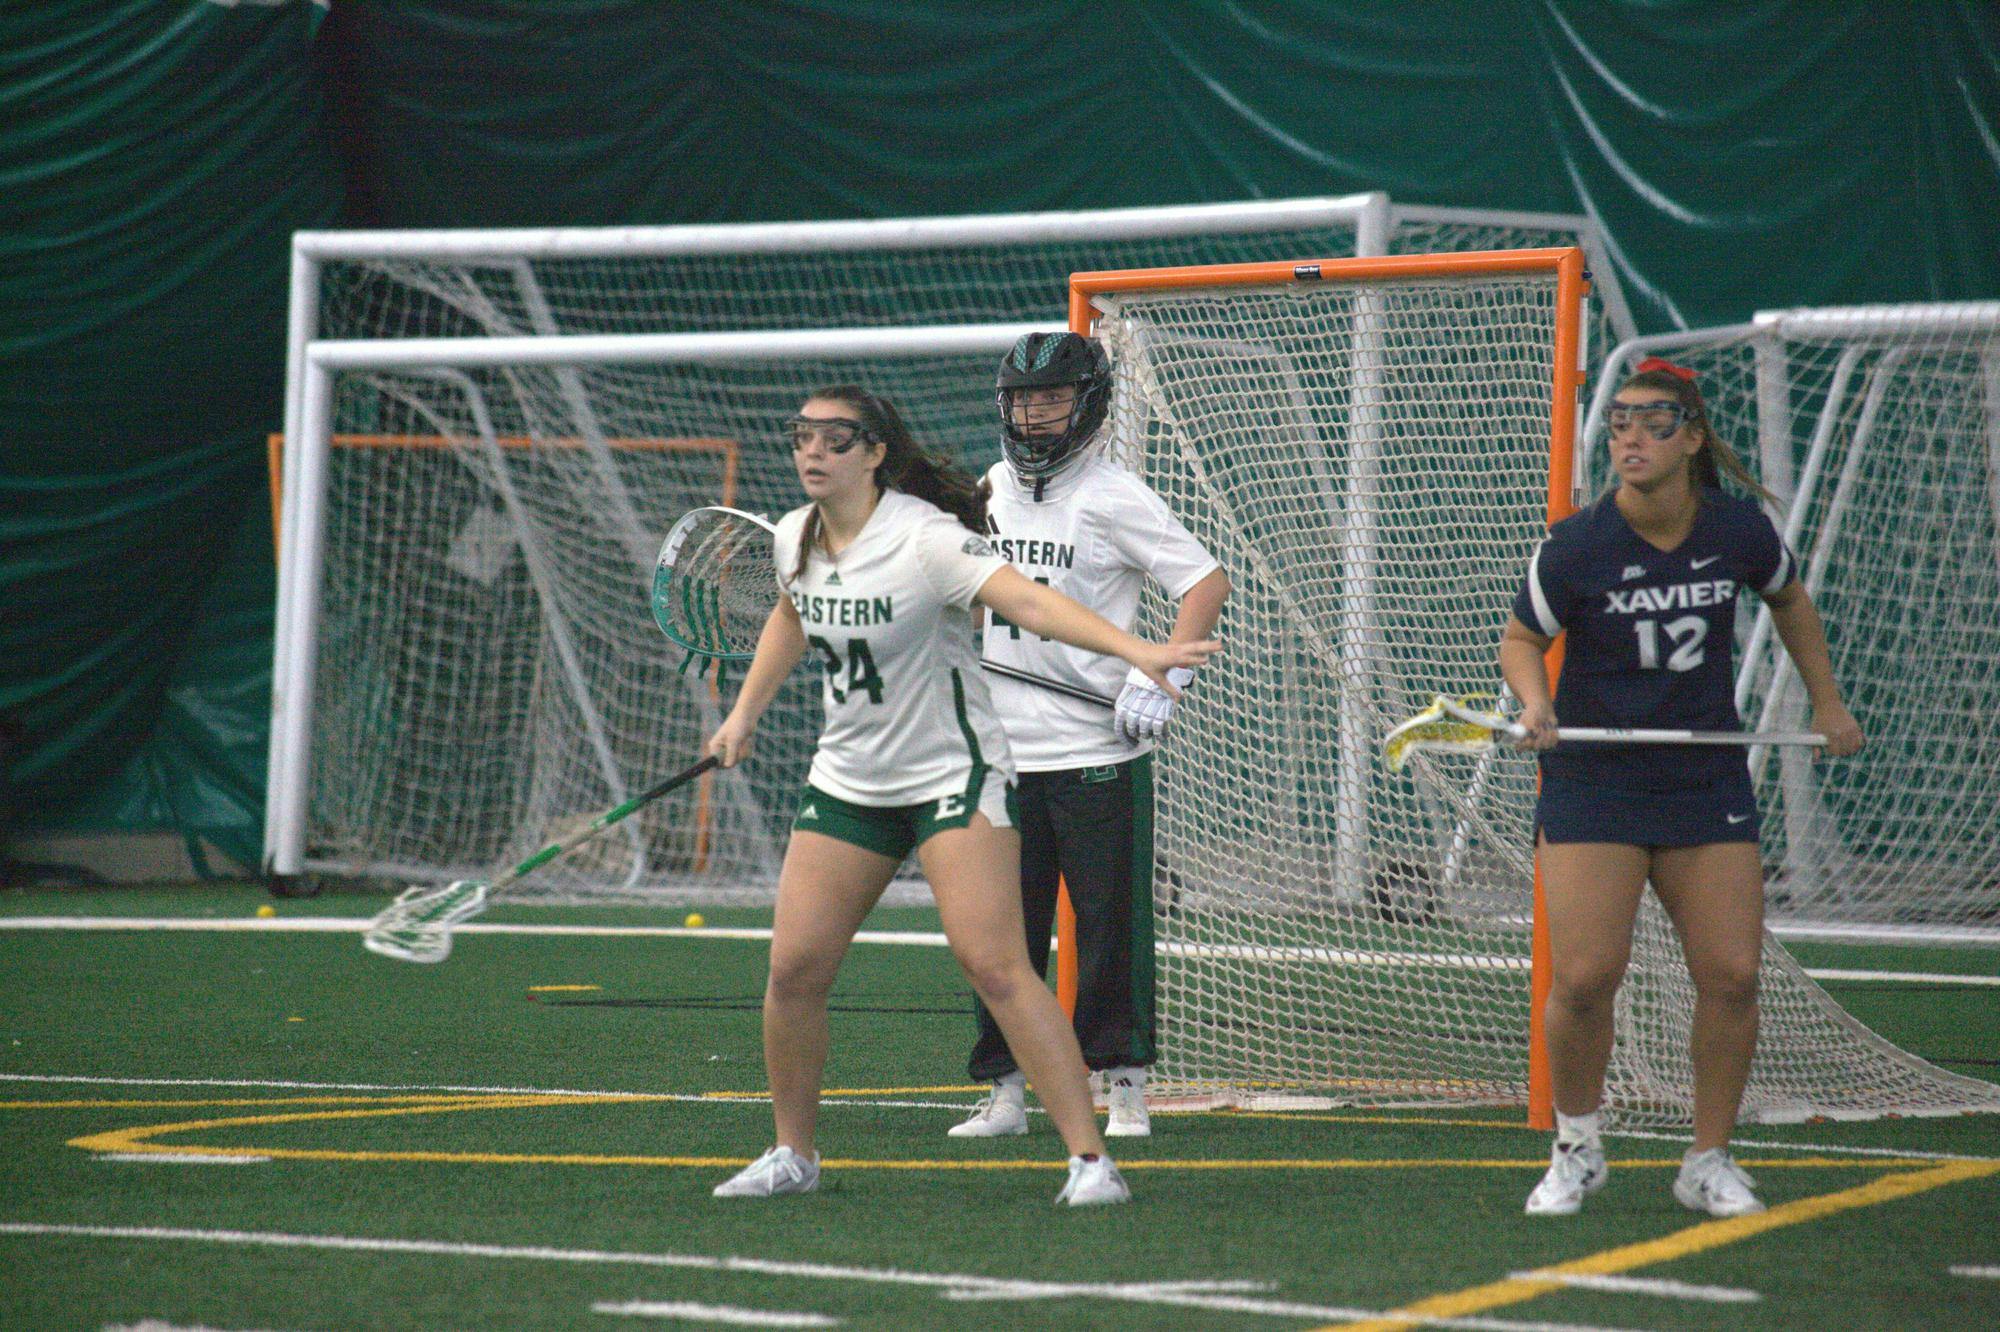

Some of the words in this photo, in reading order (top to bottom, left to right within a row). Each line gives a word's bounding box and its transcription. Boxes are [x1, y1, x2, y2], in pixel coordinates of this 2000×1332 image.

[991, 539, 1075, 570] ASTERN
[1604, 579, 1735, 614] XAVIER
[1633, 615, 1707, 672] 12
[808, 633, 885, 705] 24
[934, 792, 967, 821] E
